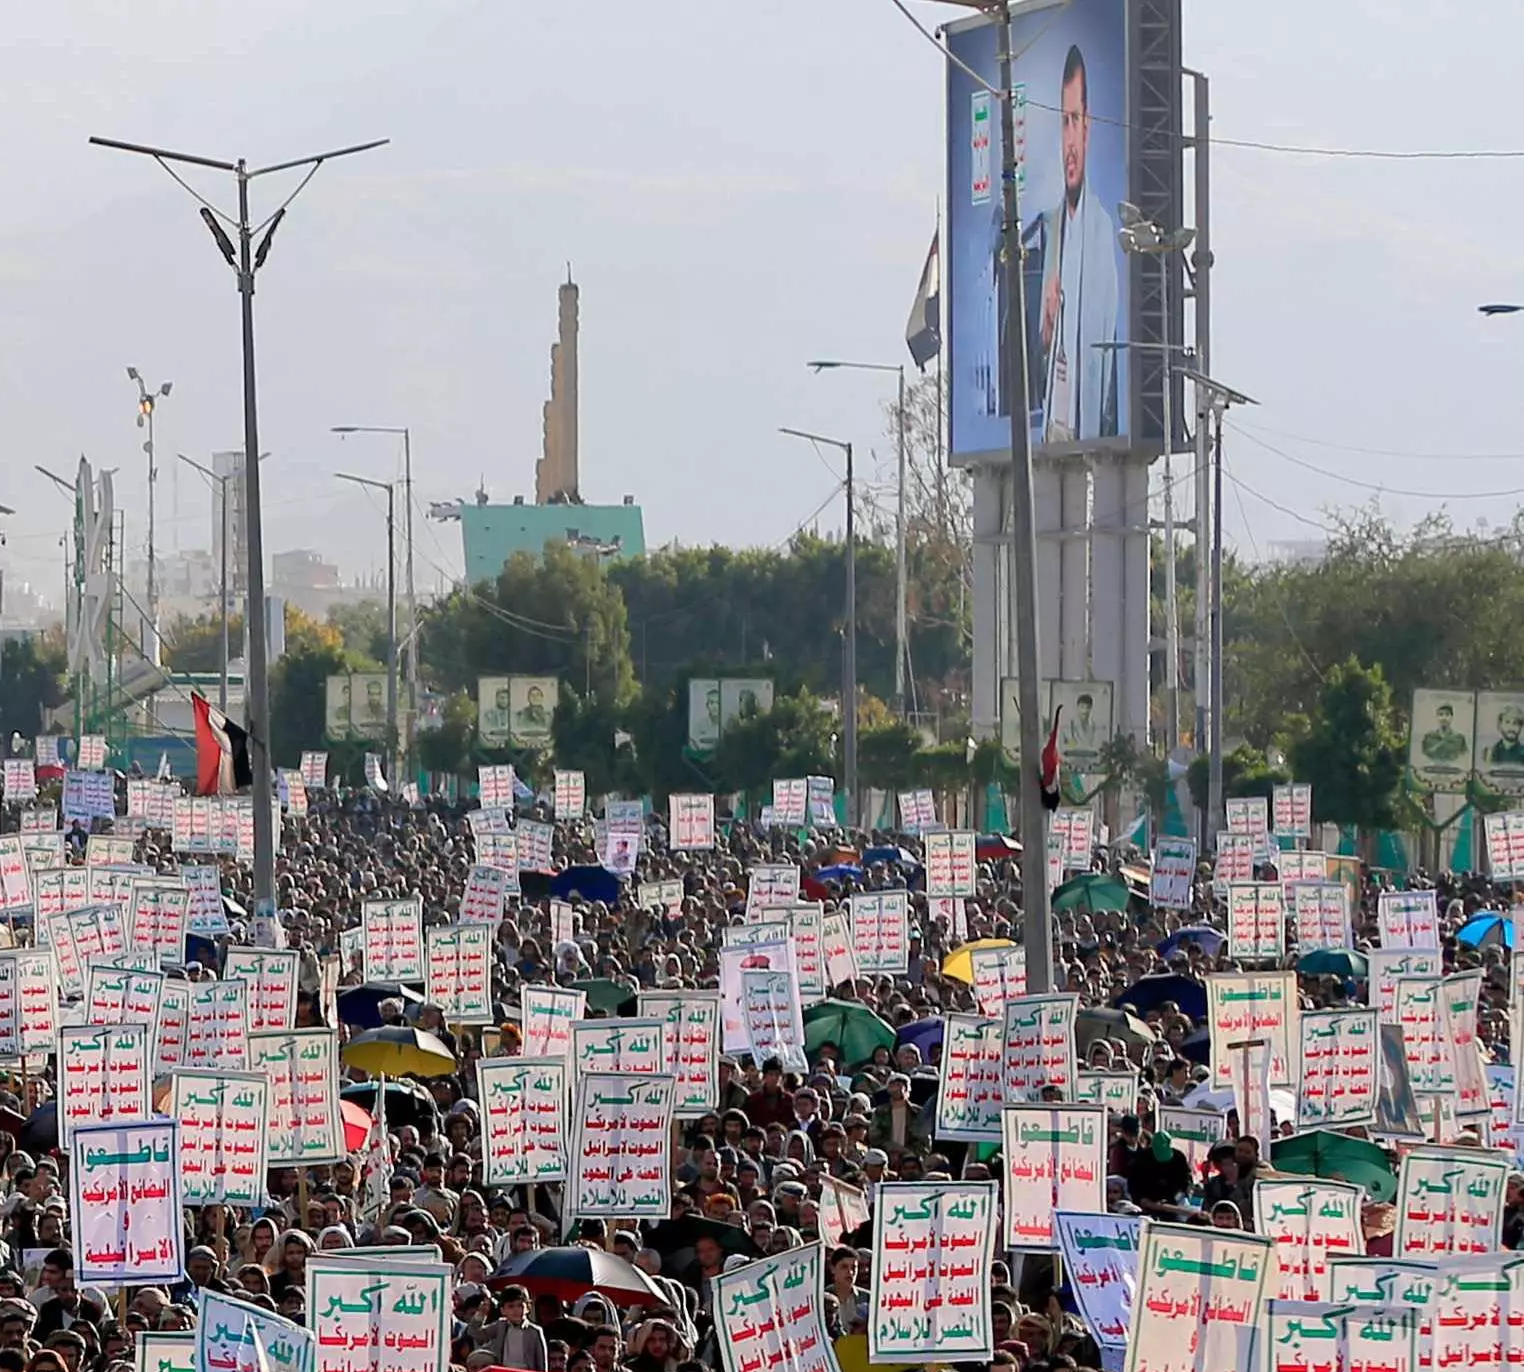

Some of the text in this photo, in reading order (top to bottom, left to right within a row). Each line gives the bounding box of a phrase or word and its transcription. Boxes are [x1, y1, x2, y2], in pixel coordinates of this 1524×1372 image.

[82, 1137, 169, 1172] قاطعوا
[82, 1177, 169, 1204] البضائع الأمريكية
[123, 1210, 130, 1231] و
[319, 1278, 438, 1322] الله أكبر
[319, 1320, 434, 1352] الموت لأمريكا
